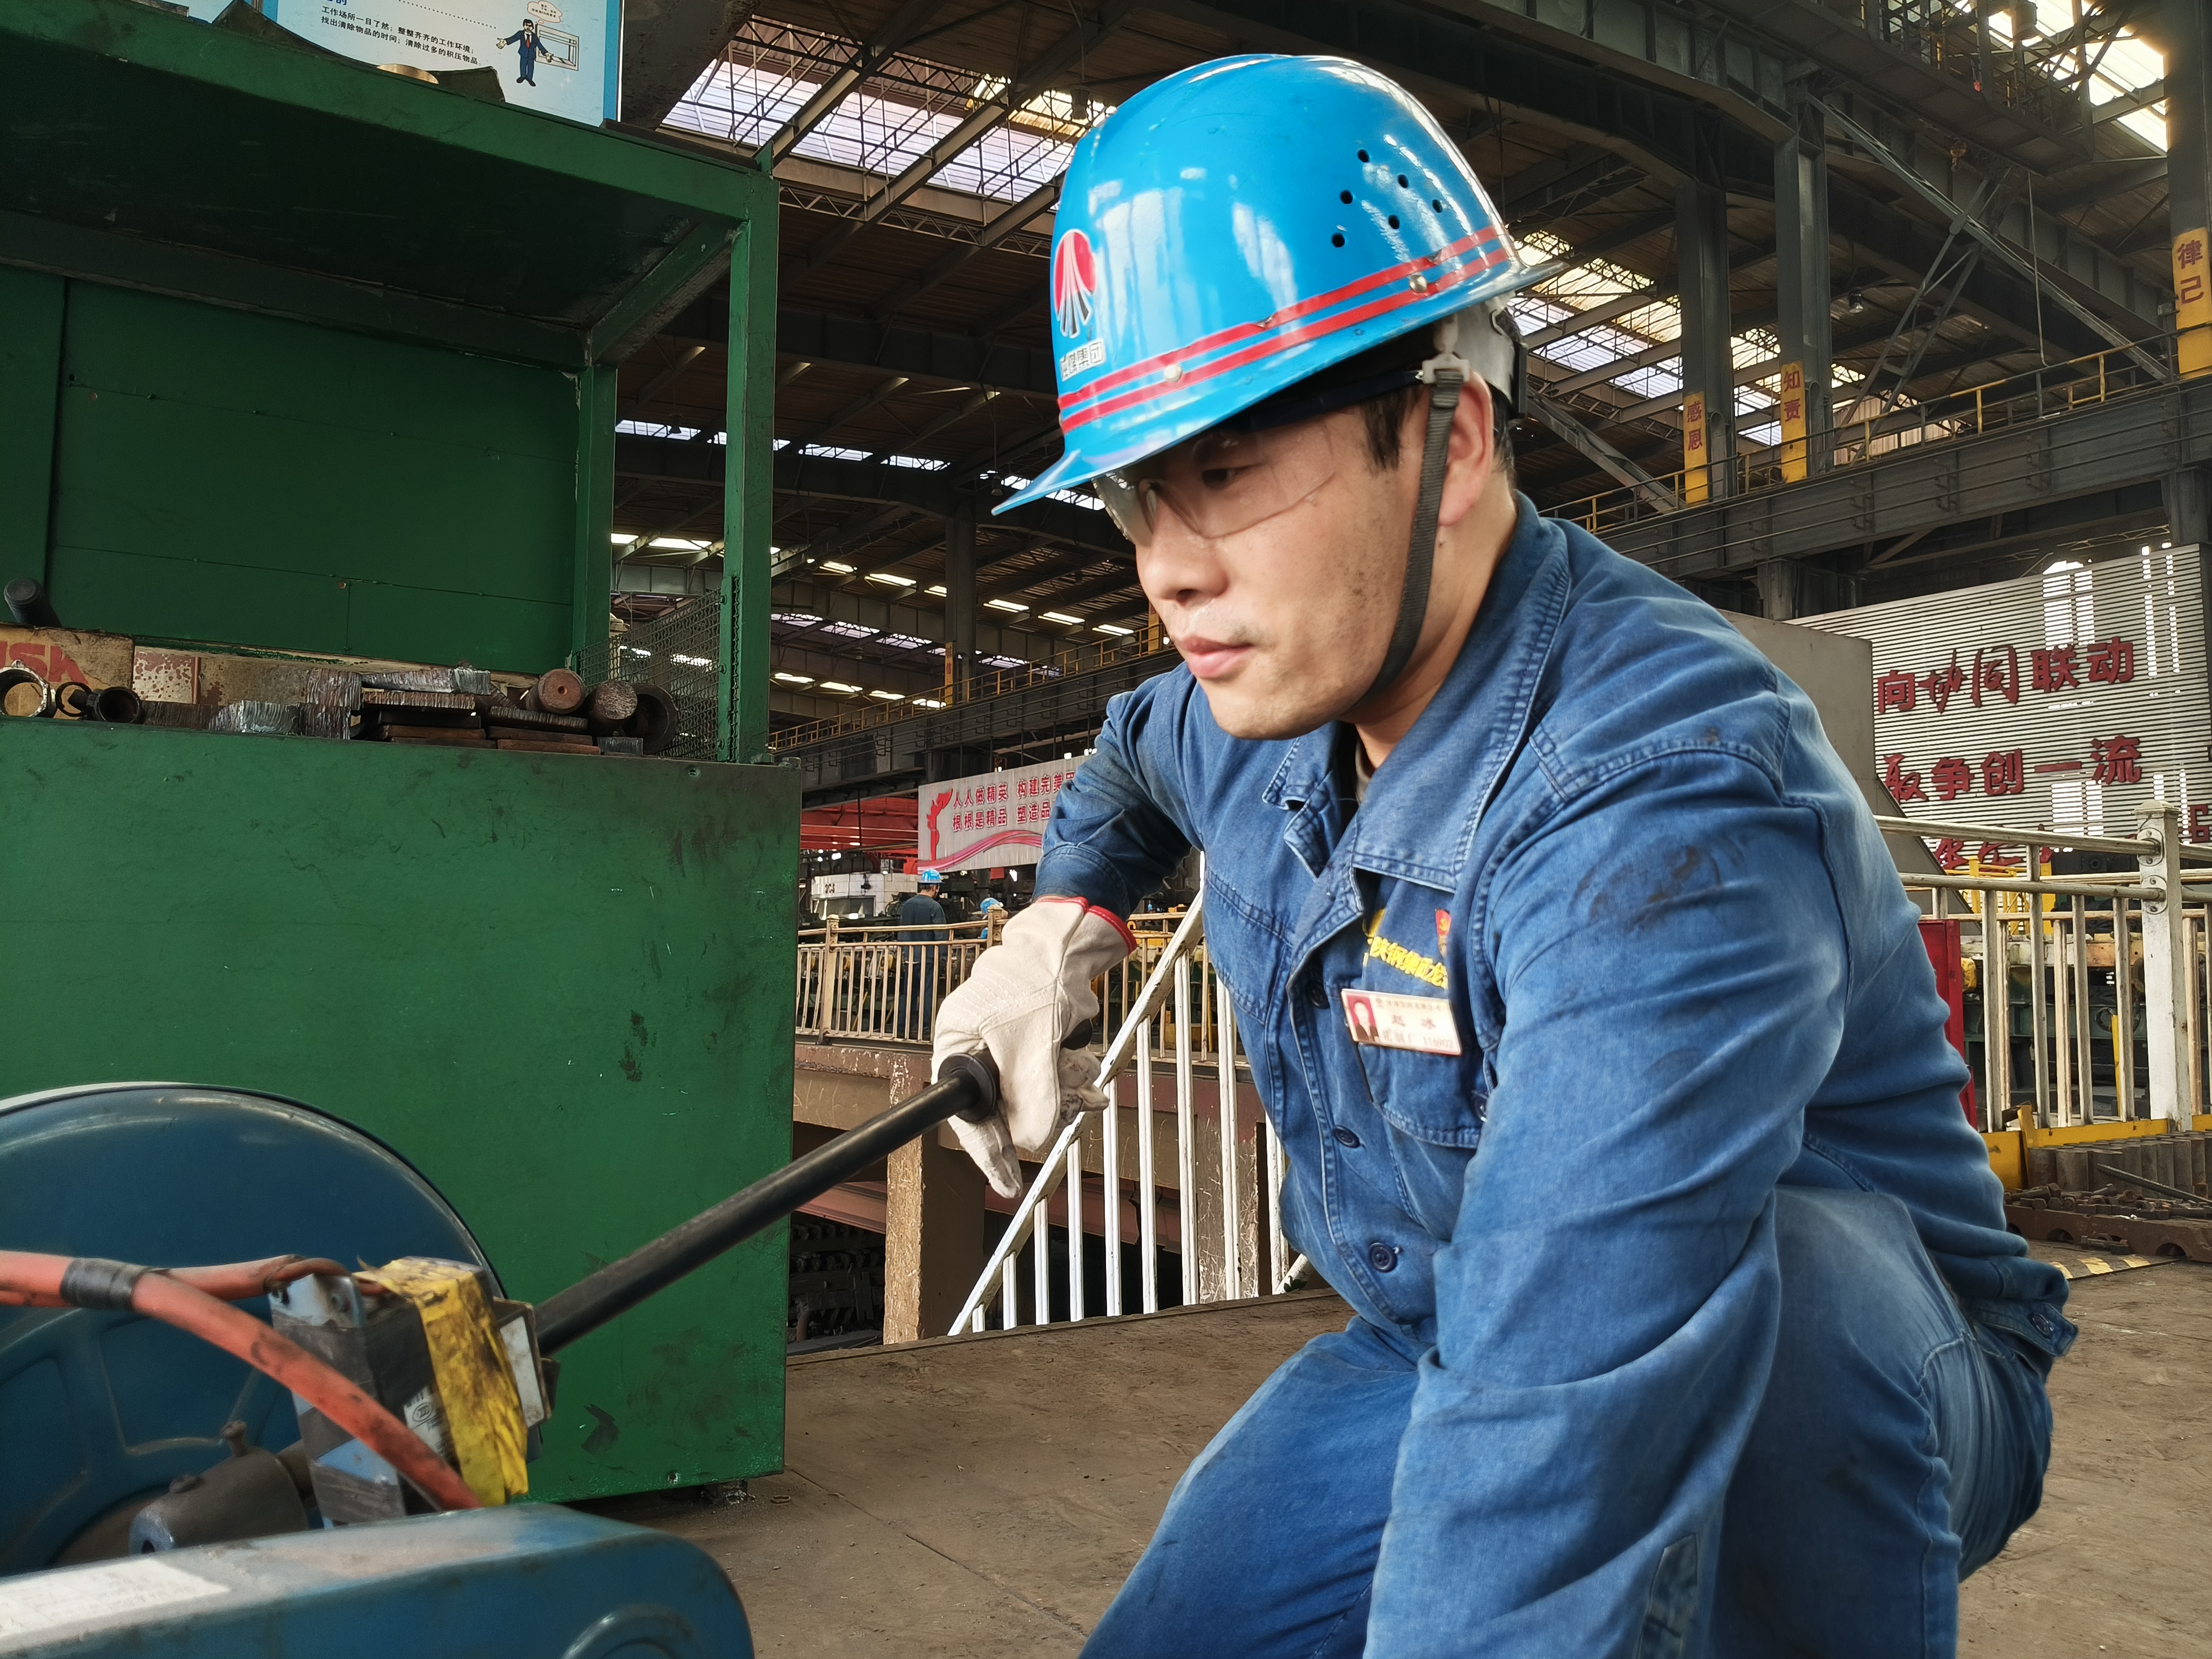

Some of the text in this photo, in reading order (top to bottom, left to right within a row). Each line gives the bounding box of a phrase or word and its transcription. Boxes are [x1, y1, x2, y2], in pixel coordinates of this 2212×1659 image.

[2177, 239, 2204, 304] 律己
[1783, 370, 1801, 422] 知责
[1687, 400, 1703, 451] 感恩
[0, 641, 89, 685] SK
[1877, 636, 2134, 714] 向协同联动
[952, 799, 1055, 832] 根根是精品 塑造品
[953, 783, 1008, 808] 人人做精英
